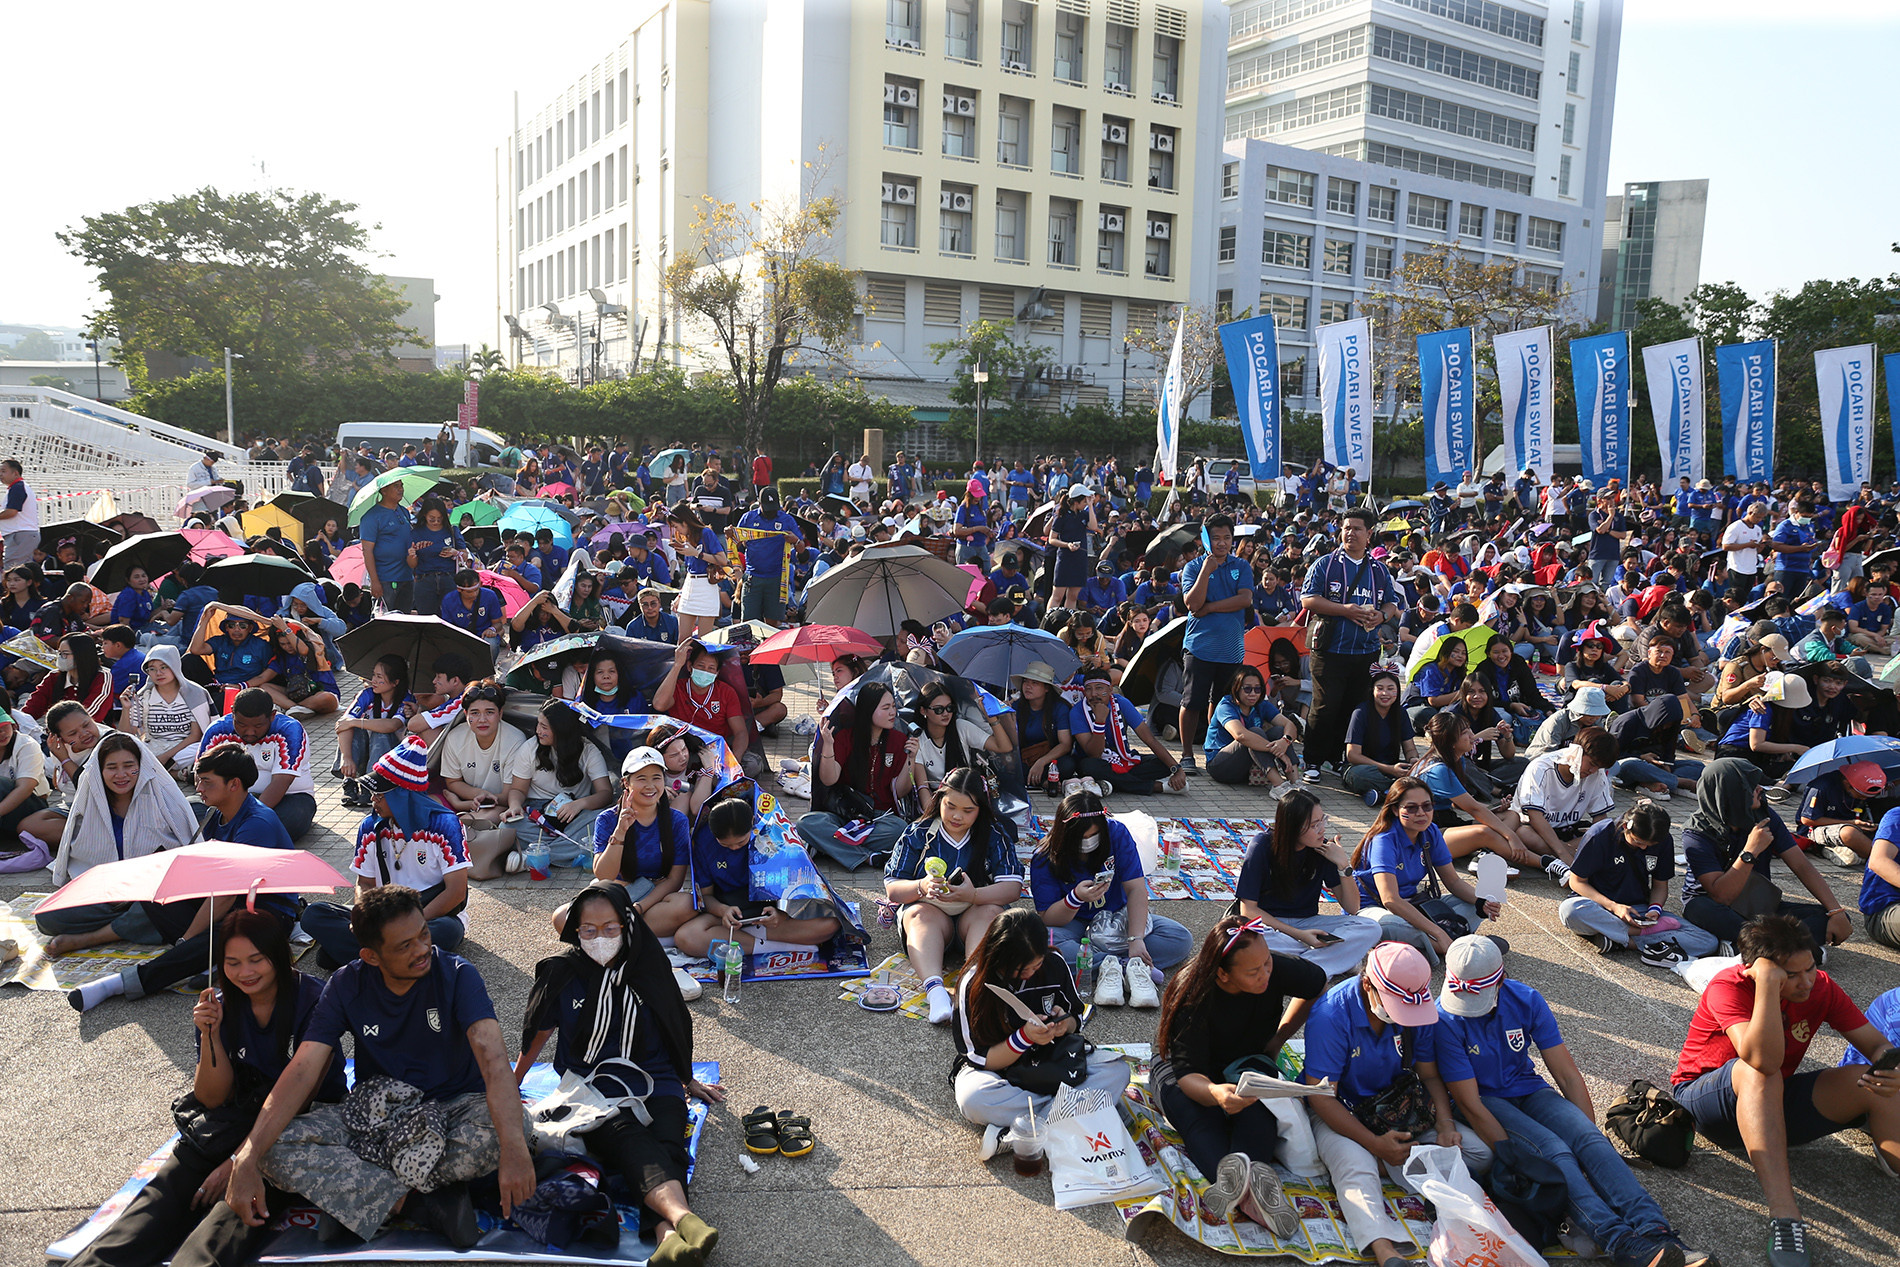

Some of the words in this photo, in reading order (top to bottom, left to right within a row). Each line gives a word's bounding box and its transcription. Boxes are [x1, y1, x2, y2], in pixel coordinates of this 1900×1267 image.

[1250, 332, 1273, 397] POCARI
[1345, 335, 1360, 399] POCARI
[1447, 343, 1462, 408] POCARI
[1526, 343, 1541, 407] POCARI
[1601, 347, 1617, 410] POCARI
[1748, 354, 1764, 417] POCARI
[1848, 360, 1864, 421] POCARI
[1349, 404, 1364, 463] SWEAT
[1450, 411, 1466, 469] SWEAT
[1529, 411, 1542, 467] SWEAT
[1604, 414, 1618, 470] SWEAT
[1679, 420, 1692, 475] SWEAT
[1750, 420, 1765, 477] SWEAT
[761, 793, 772, 813] 105
[1081, 1148, 1126, 1163] WARRIX
